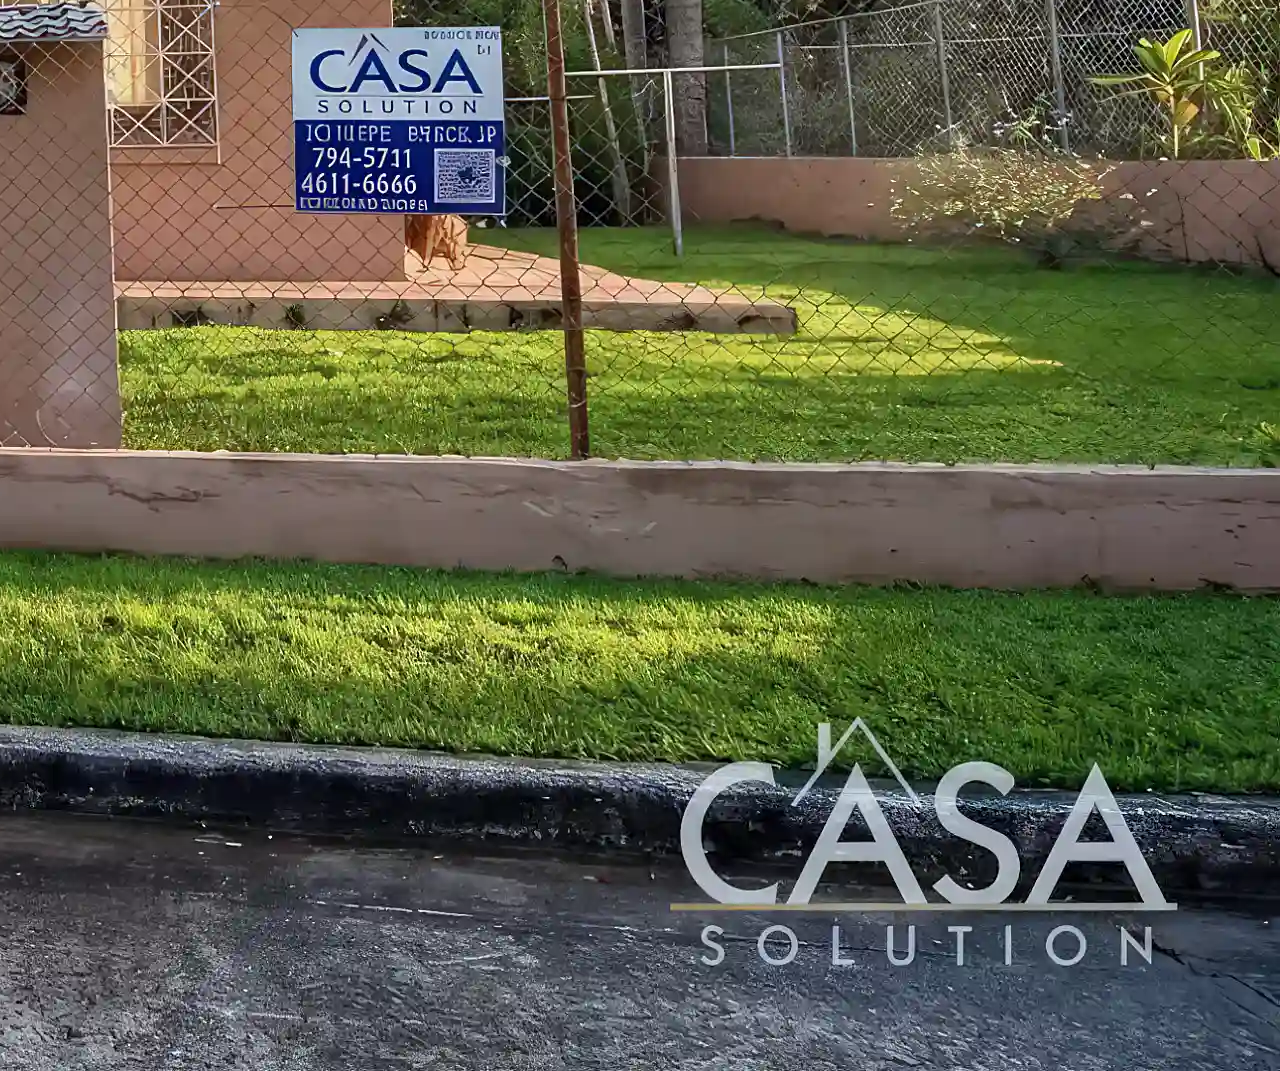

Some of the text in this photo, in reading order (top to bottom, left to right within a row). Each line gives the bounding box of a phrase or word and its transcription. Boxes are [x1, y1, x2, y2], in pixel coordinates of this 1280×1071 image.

[309, 47, 484, 94] CASA
[317, 99, 477, 114] SOLUTION
[312, 146, 412, 169] 794-5711
[300, 172, 417, 195] 4611-6666
